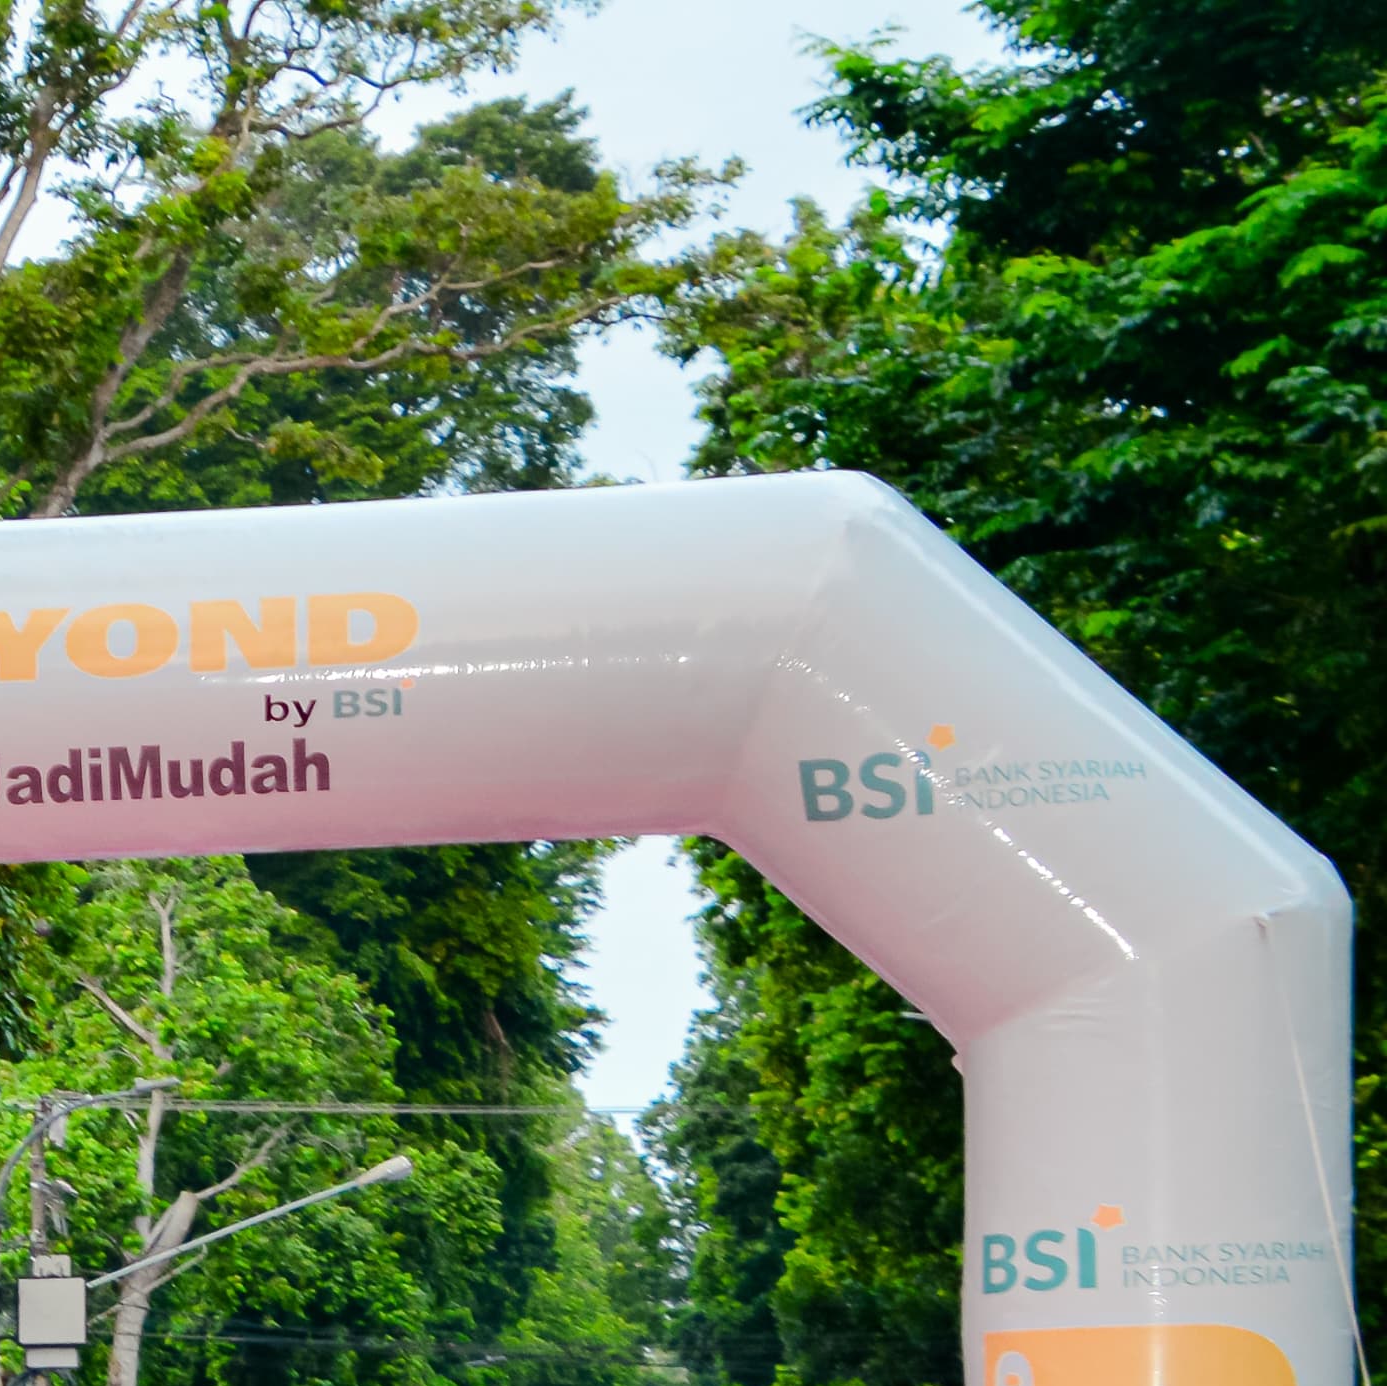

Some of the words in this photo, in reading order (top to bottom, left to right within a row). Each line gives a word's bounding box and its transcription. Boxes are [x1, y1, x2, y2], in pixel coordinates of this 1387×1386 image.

[264, 693, 316, 728] by
[955, 762, 1031, 788] BANK
[1039, 759, 1147, 782] SYARIAH
[982, 1203, 1124, 1294] BSI
[1122, 1244, 1210, 1265] BANK
[1219, 1241, 1325, 1264] SYARIAH
[1122, 1265, 1292, 1289] INDONESIA
